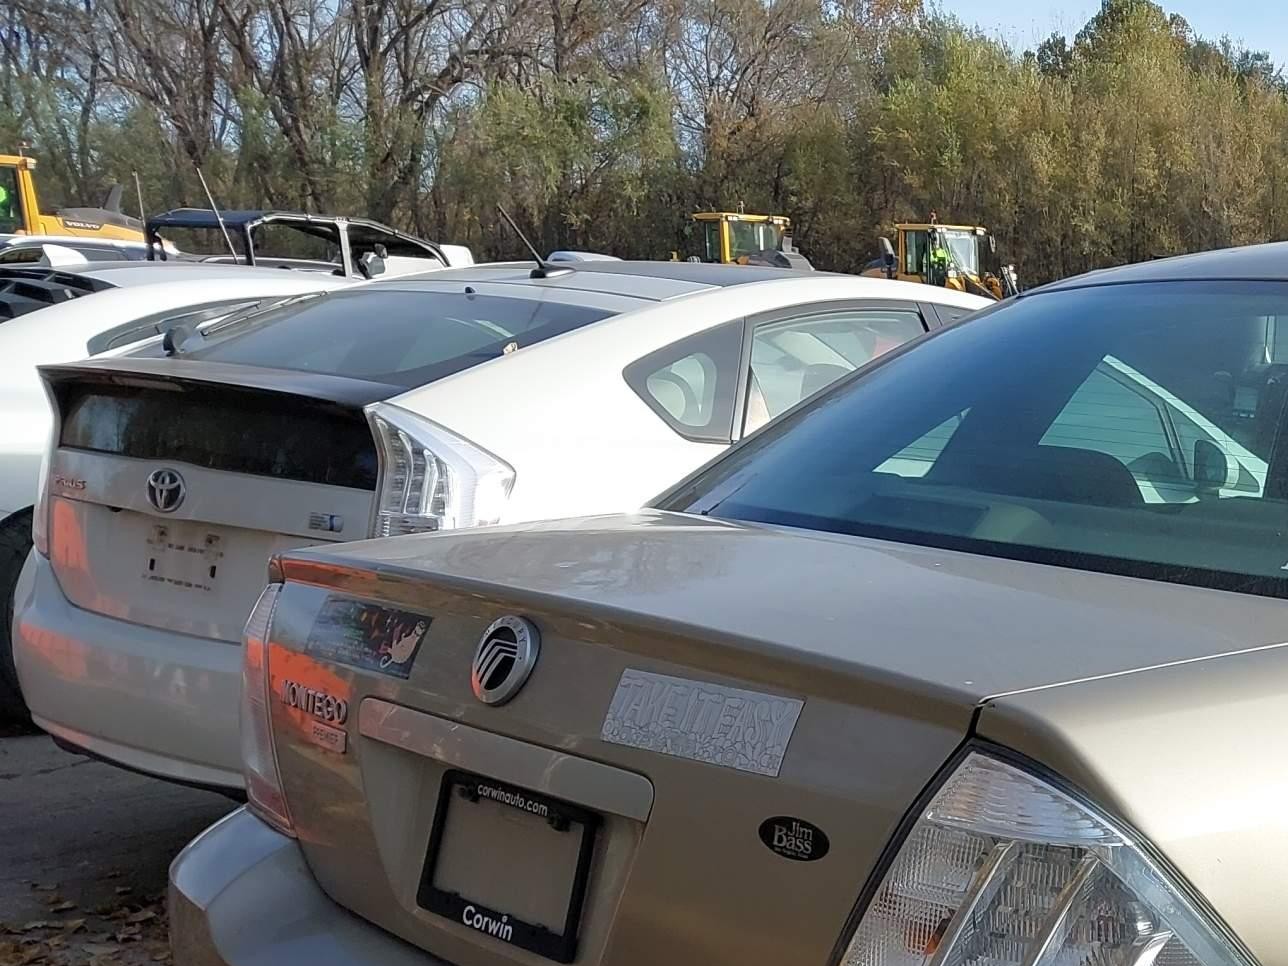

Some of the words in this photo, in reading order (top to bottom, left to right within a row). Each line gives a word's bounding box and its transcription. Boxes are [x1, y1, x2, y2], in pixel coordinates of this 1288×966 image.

[64, 220, 99, 229] VOLVO
[280, 679, 348, 724] MONTEGO
[477, 784, 548, 816] corwinauto.com
[772, 824, 813, 854] Bass
[787, 821, 813, 841] Jim
[462, 905, 513, 941] Corwin
